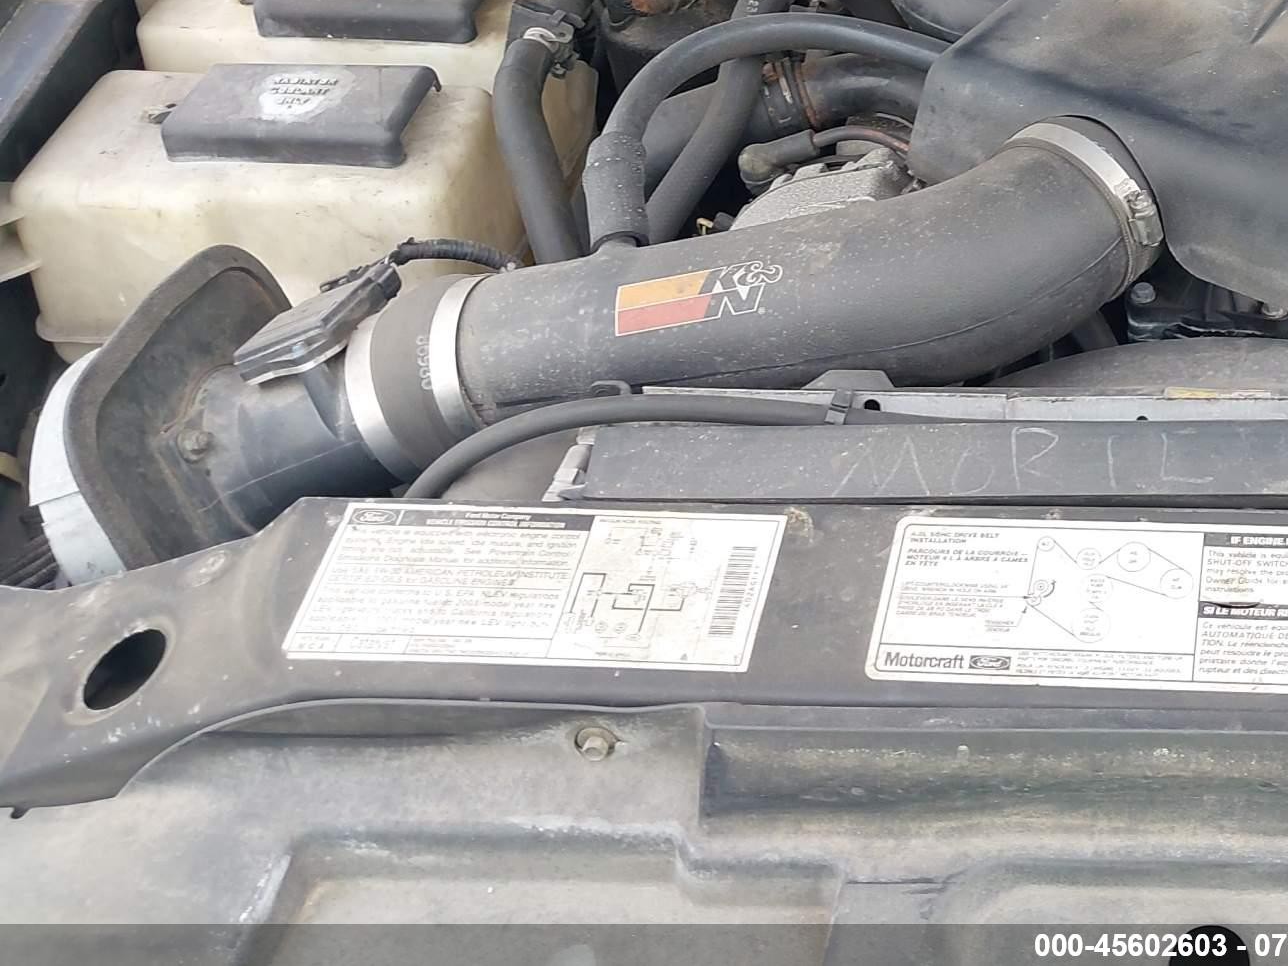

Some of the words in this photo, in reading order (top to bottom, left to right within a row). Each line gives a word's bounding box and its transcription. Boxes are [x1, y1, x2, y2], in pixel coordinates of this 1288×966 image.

[1243, 537, 1284, 546] ENGINE
[1202, 607, 1215, 615] SI
[1216, 608, 1229, 616] LE
[1230, 608, 1276, 616] MOTEUR
[884, 651, 964, 670] Motorcraft
